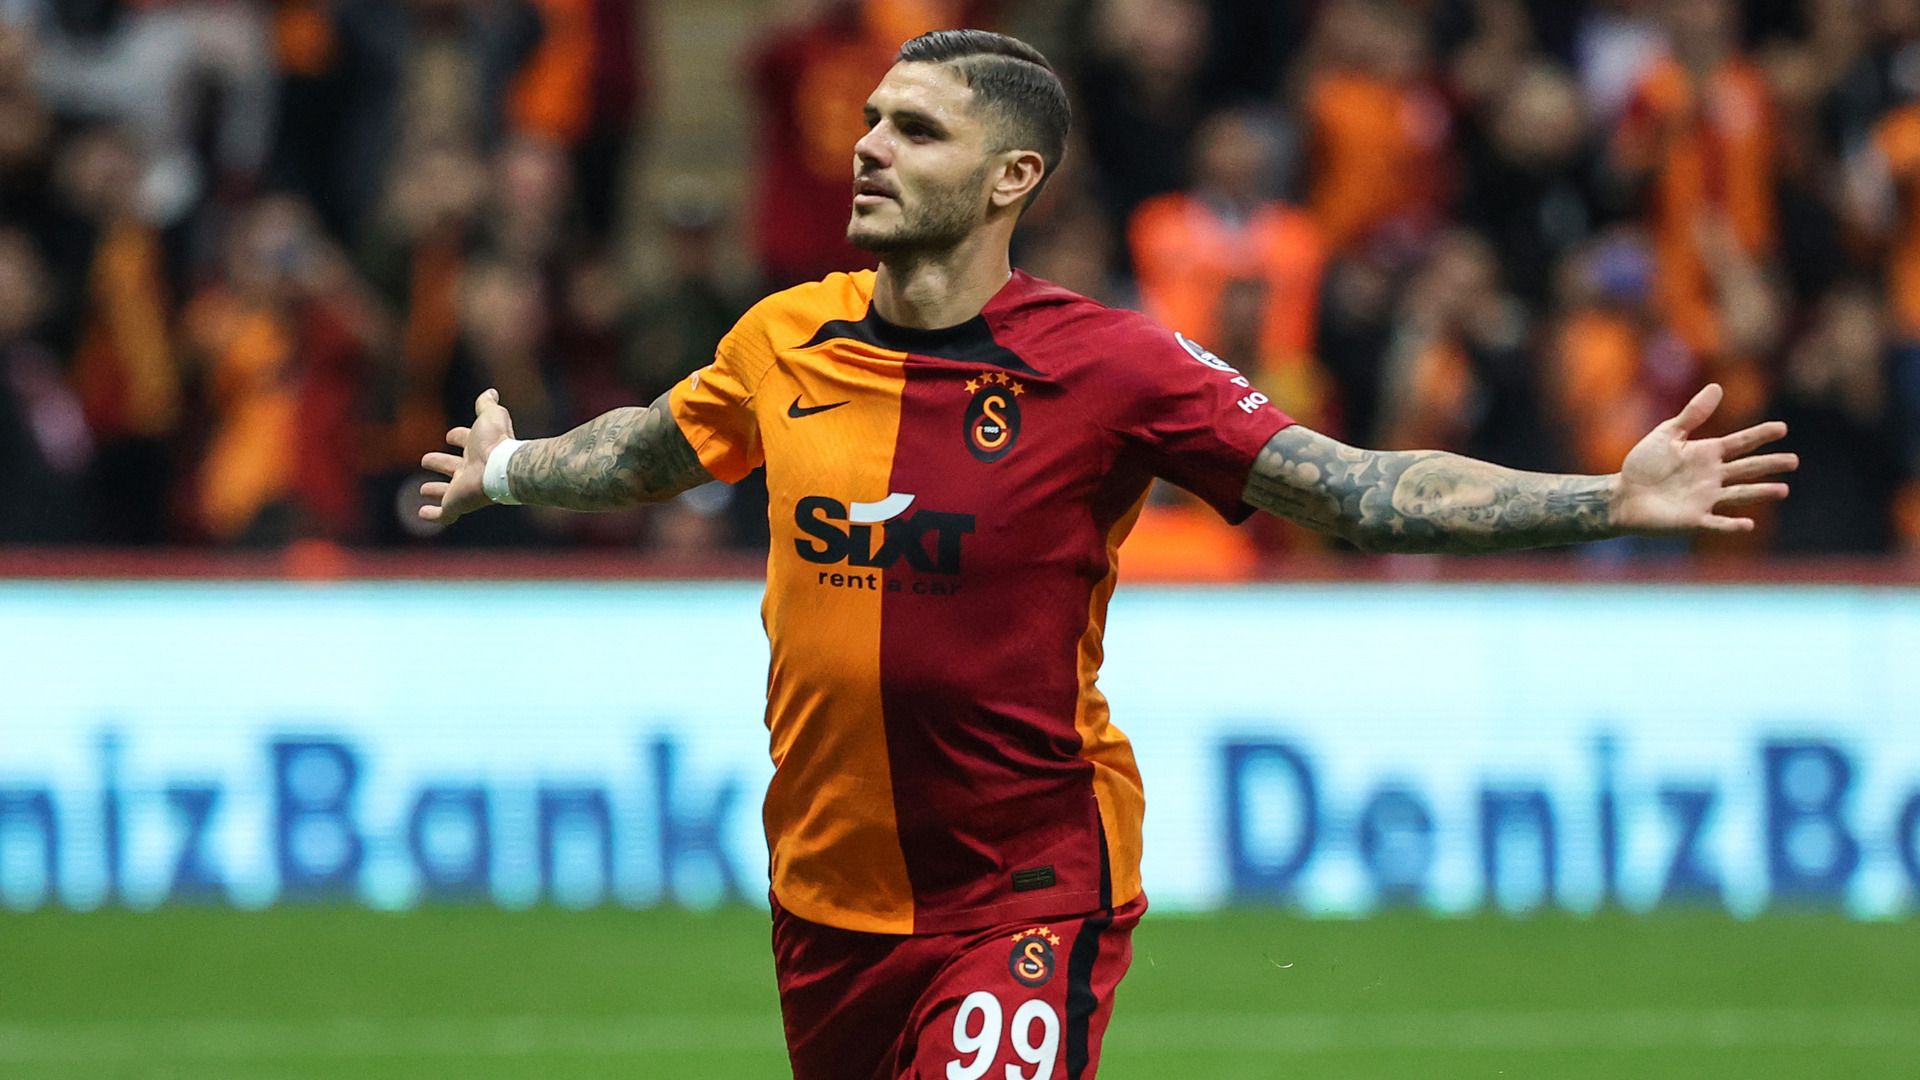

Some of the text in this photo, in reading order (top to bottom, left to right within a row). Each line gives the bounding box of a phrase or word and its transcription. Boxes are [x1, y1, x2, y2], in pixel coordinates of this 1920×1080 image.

[818, 571, 962, 597] rent a car
[946, 991, 1060, 1080] 99
